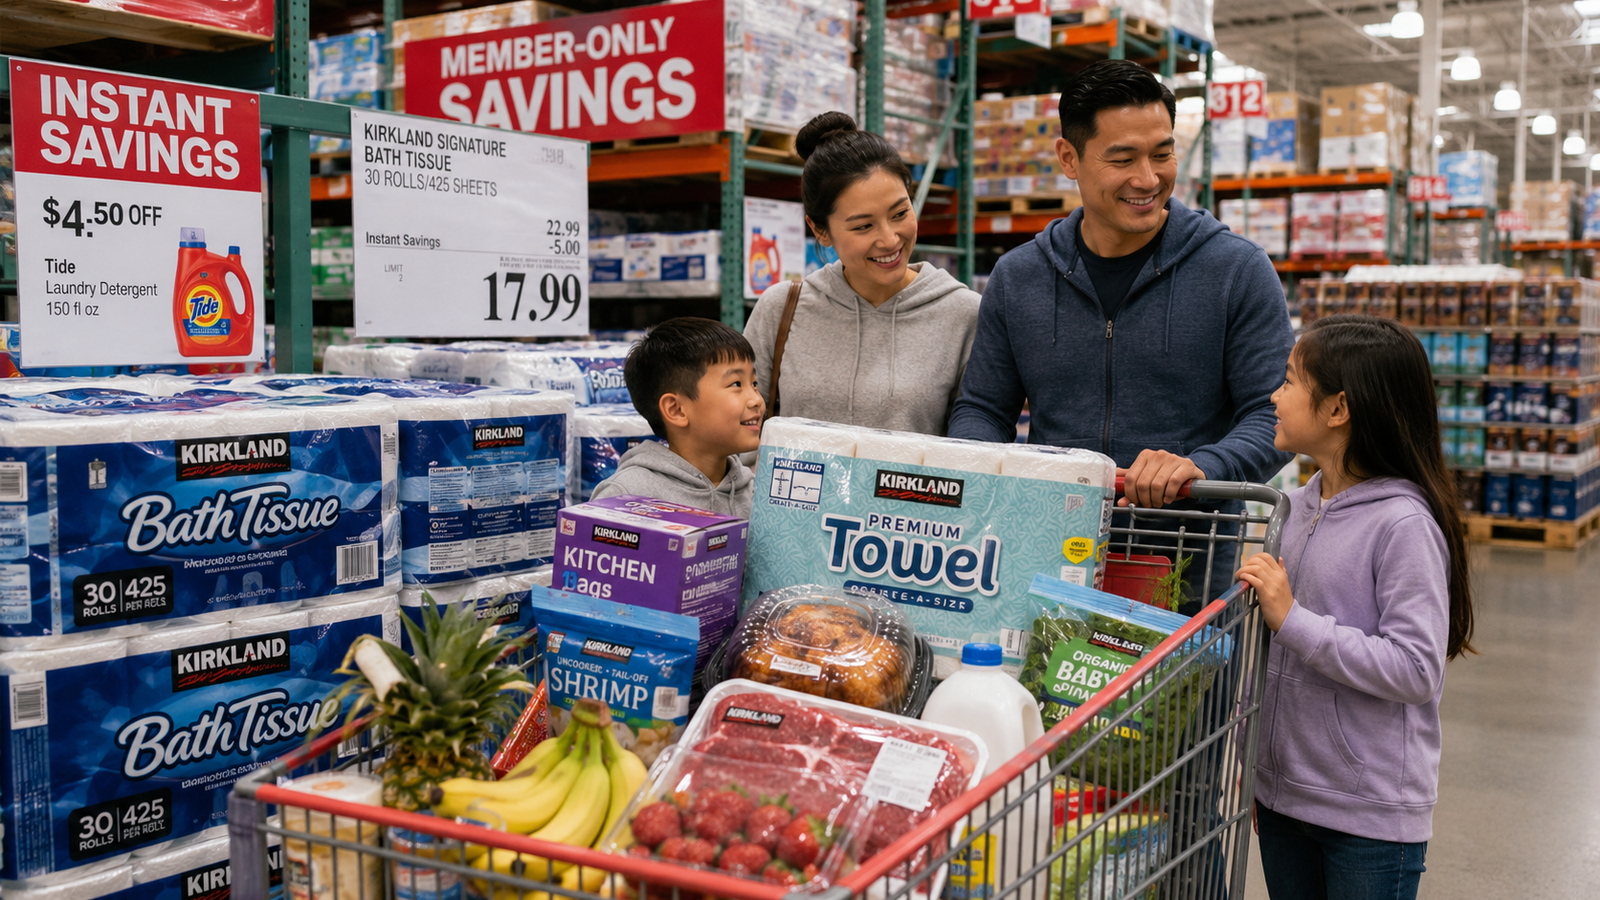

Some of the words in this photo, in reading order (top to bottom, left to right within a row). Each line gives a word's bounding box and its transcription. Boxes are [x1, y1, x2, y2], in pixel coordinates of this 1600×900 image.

[440, 17, 676, 79] MEMBER-ONLY
[40, 74, 231, 135] INSTANT
[439, 57, 697, 133] SAVINGS
[1209, 82, 1261, 114] 312
[40, 120, 240, 180] SAVINGS
[364, 123, 433, 148] KIRKLAND
[437, 133, 507, 158] SIGNATURE
[364, 146, 401, 167] BATH
[405, 151, 452, 172] TISSUE
[364, 168, 380, 186] 30
[384, 170, 450, 192] ROLLS/425
[453, 178, 498, 197] SHEETS
[128, 204, 162, 226] OFF
[546, 219, 580, 237] 22.99
[366, 232, 401, 246] Instant
[403, 234, 441, 250] Savings
[549, 239, 580, 256] -5.00
[44, 258, 76, 274] Tide
[46, 280, 96, 298] Laundry
[100, 281, 158, 299] Detergent
[483, 271, 582, 322] 17.99
[46, 301, 70, 316] 150
[73, 301, 81, 316] fl
[85, 305, 99, 316] oz
[189, 295, 219, 323] Tide
[475, 426, 524, 441] KIRKLAND
[181, 438, 288, 464] KIRKLAND
[879, 473, 961, 497] KIRKLAND
[122, 493, 236, 553] Bath
[230, 485, 339, 542] Tissue
[869, 514, 961, 540] PREMIUM
[594, 526, 639, 543] KIRKLAND
[563, 545, 657, 584] KITCHEN
[823, 514, 998, 595] Towel
[83, 581, 116, 606] 30
[124, 575, 166, 599] 425
[83, 604, 117, 617] ROLLS
[177, 638, 287, 675] KIRKLAND
[584, 640, 632, 657] KIRKLAND
[551, 667, 648, 710] SHRIMP
[118, 705, 236, 778] Bath
[229, 691, 339, 751] Tissue
[79, 811, 113, 839] 30
[122, 798, 164, 826] 425
[79, 834, 114, 851] ROLLS
